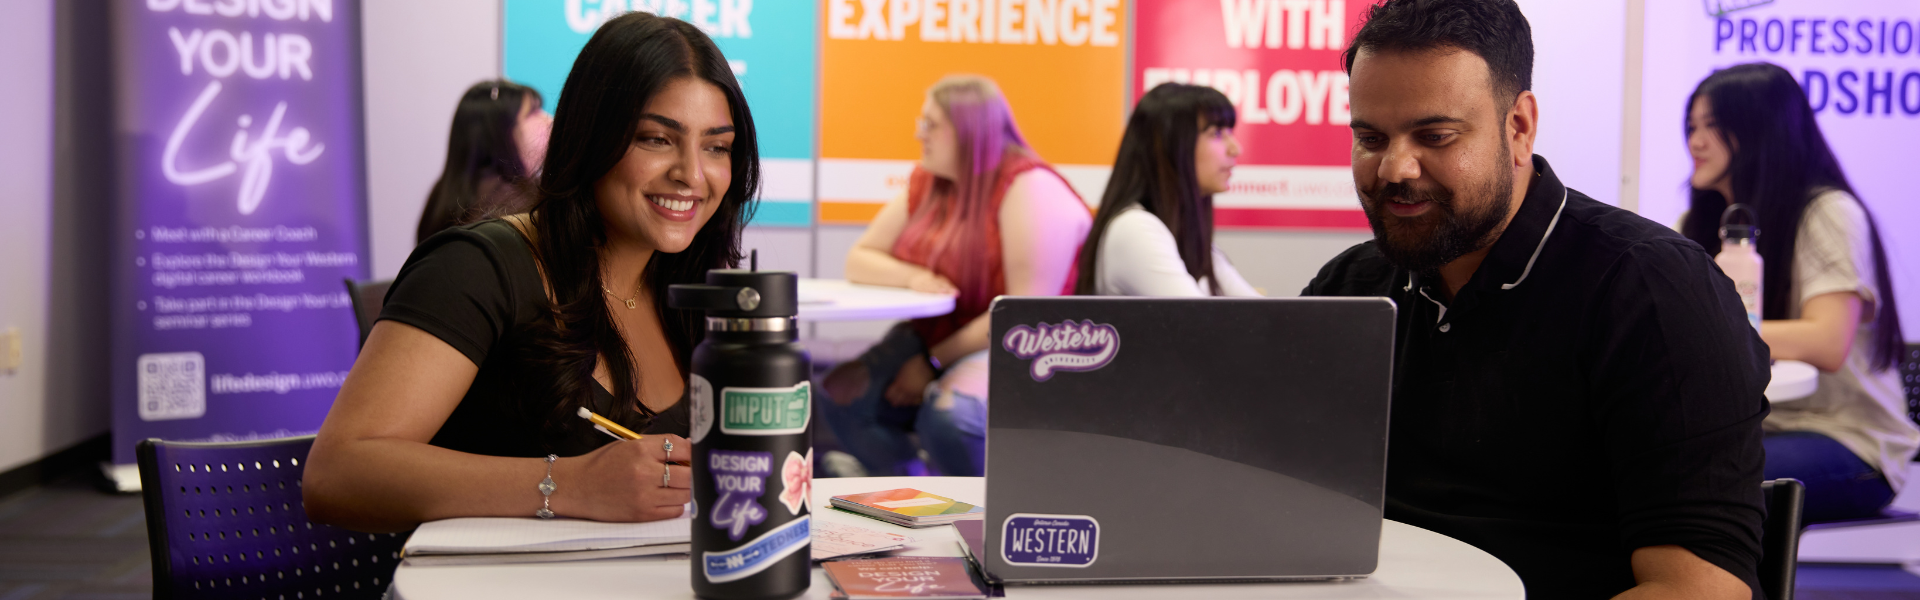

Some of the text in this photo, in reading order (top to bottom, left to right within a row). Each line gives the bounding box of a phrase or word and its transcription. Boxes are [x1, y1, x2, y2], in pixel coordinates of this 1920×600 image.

[564, 0, 752, 38] CER
[827, 0, 1119, 46] EXPERIENCE
[1220, 0, 1347, 50] WITH
[1714, 18, 1920, 55] PROFESSIO
[168, 26, 313, 81] YOUR
[1803, 70, 1920, 115] DSHO
[161, 79, 326, 216] Life
[1007, 324, 1112, 355] Western
[729, 395, 785, 425] INPUT
[710, 453, 769, 473] DESIGN
[716, 475, 762, 492] YOUR
[712, 492, 764, 537] Life
[1012, 528, 1090, 555] WESTERN
[858, 570, 941, 578] DESIGN
[874, 581, 946, 594] Life
